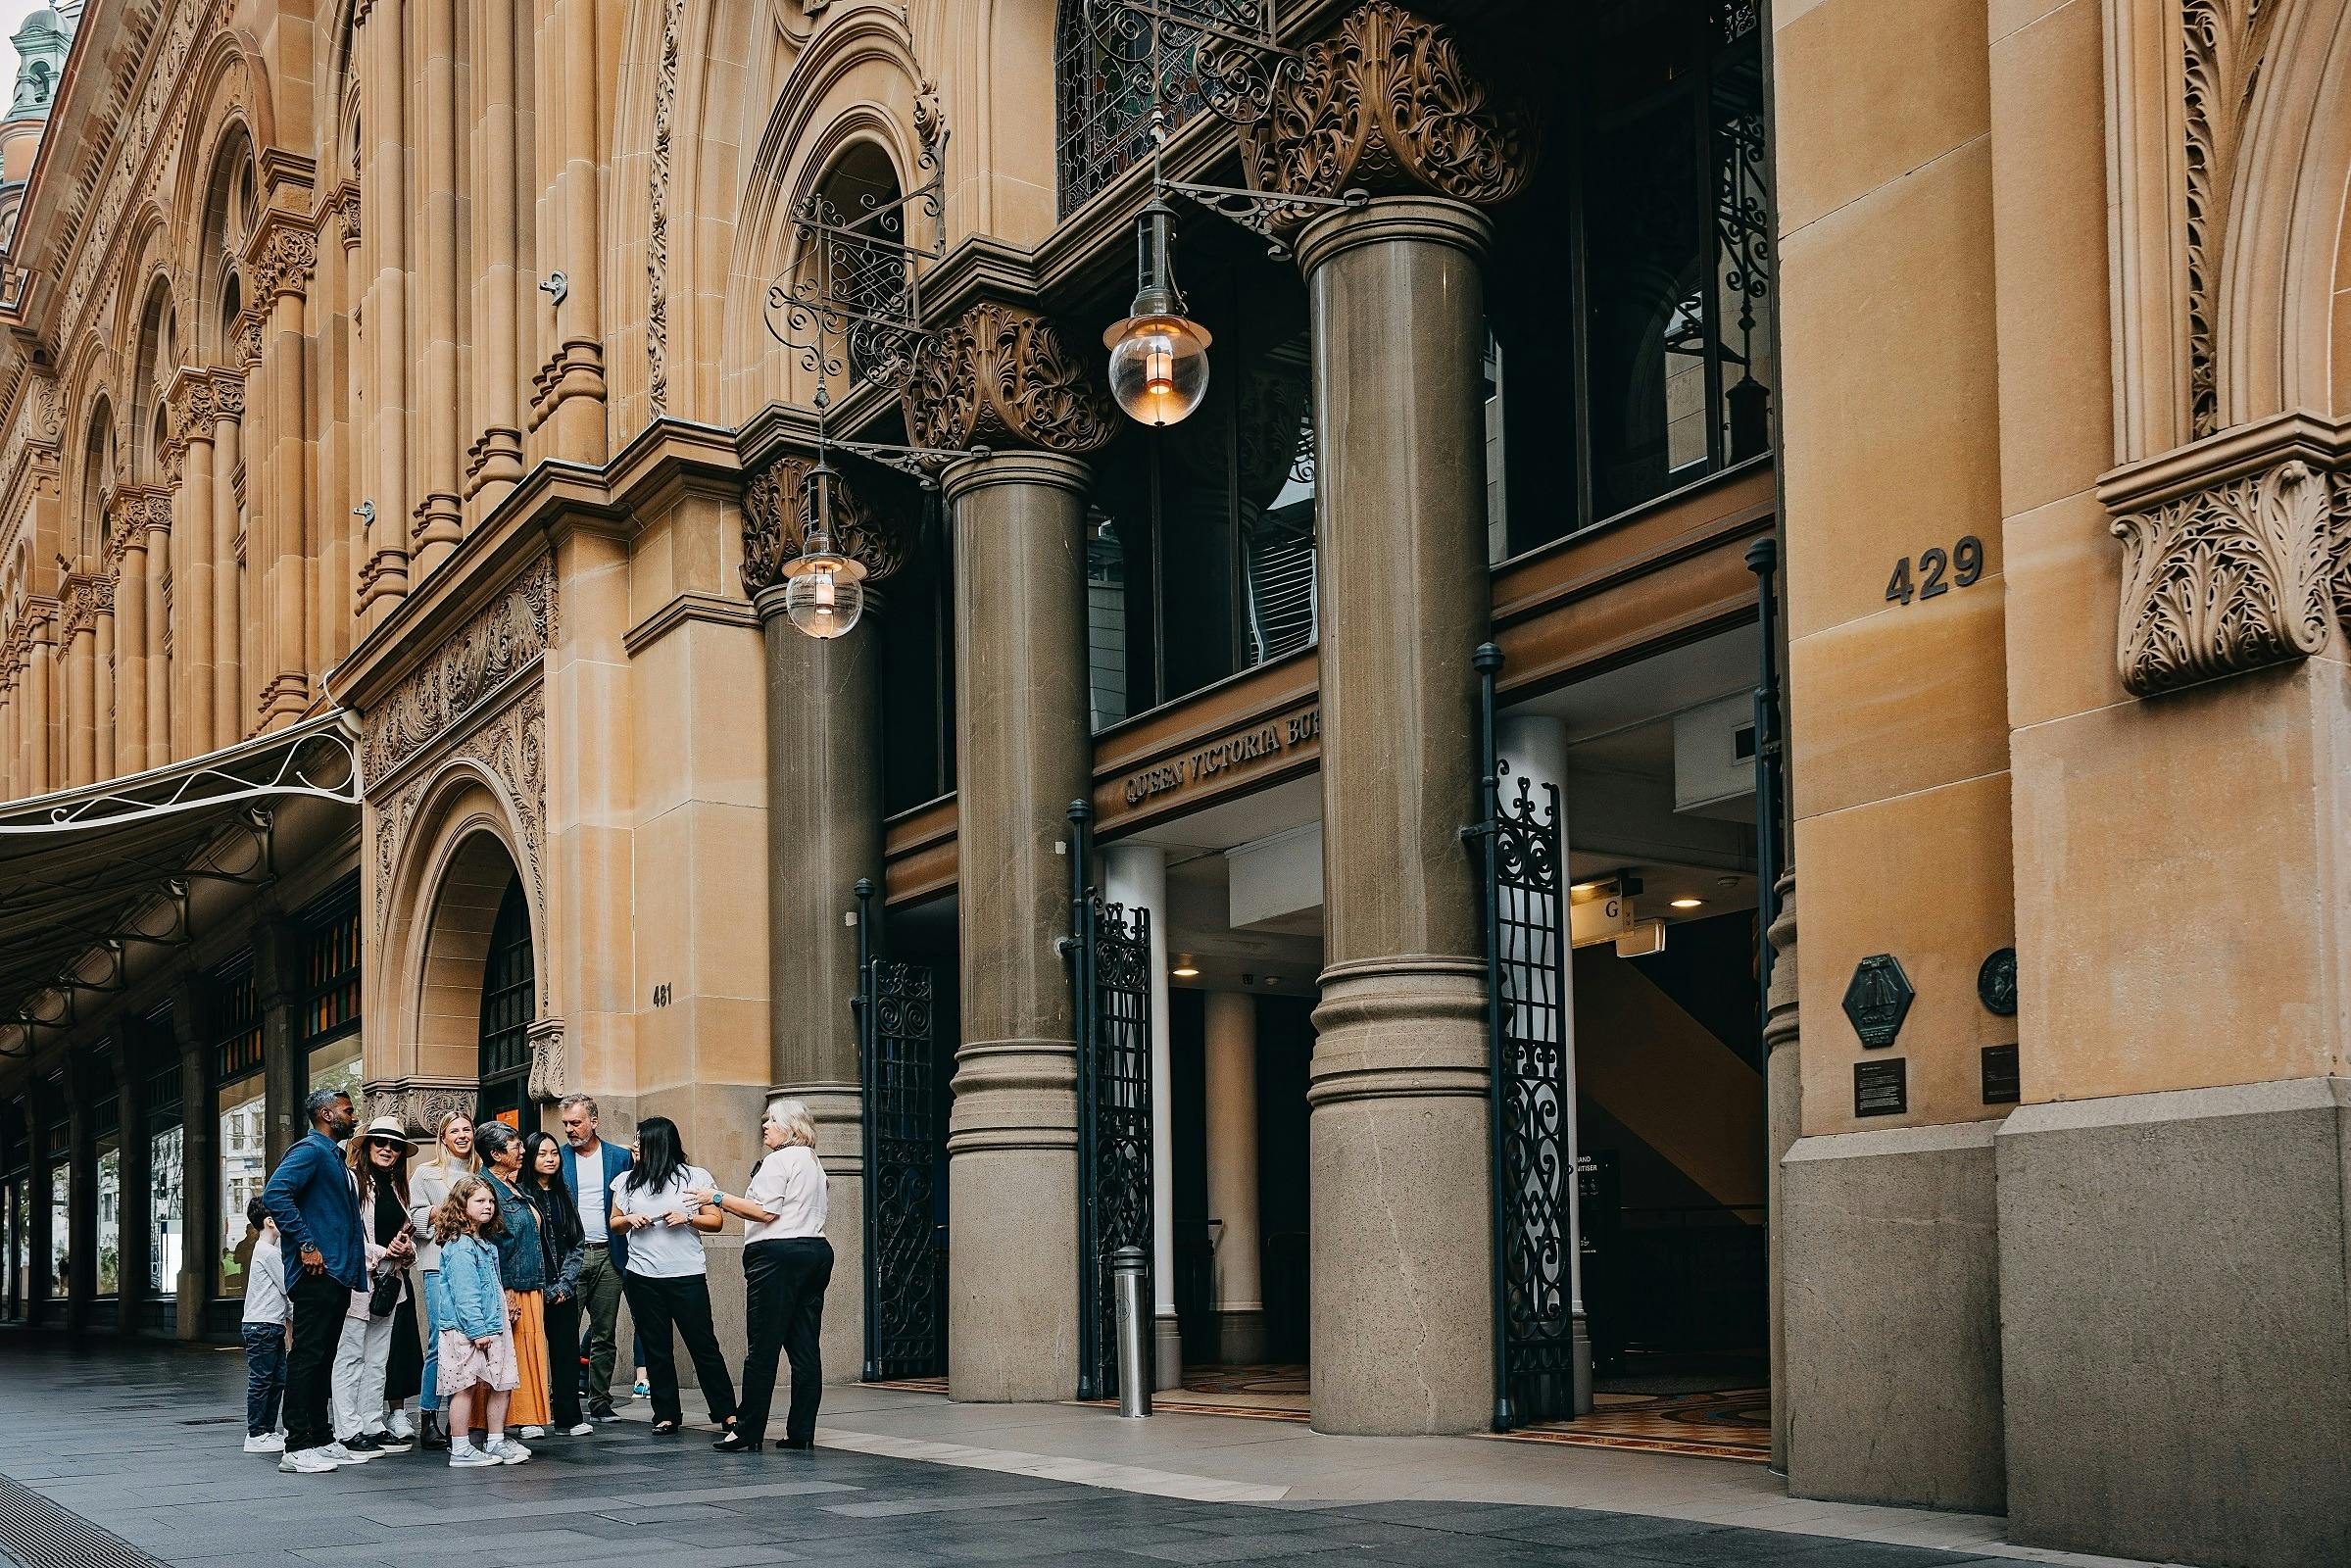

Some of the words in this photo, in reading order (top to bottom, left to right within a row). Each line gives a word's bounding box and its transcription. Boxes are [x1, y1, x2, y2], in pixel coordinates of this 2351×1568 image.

[1886, 535, 1984, 606] 429
[1126, 760, 1185, 804] QUEEN
[1189, 724, 1280, 779] VICTORIA
[1605, 900, 1619, 918] G
[653, 981, 672, 1007] 481
